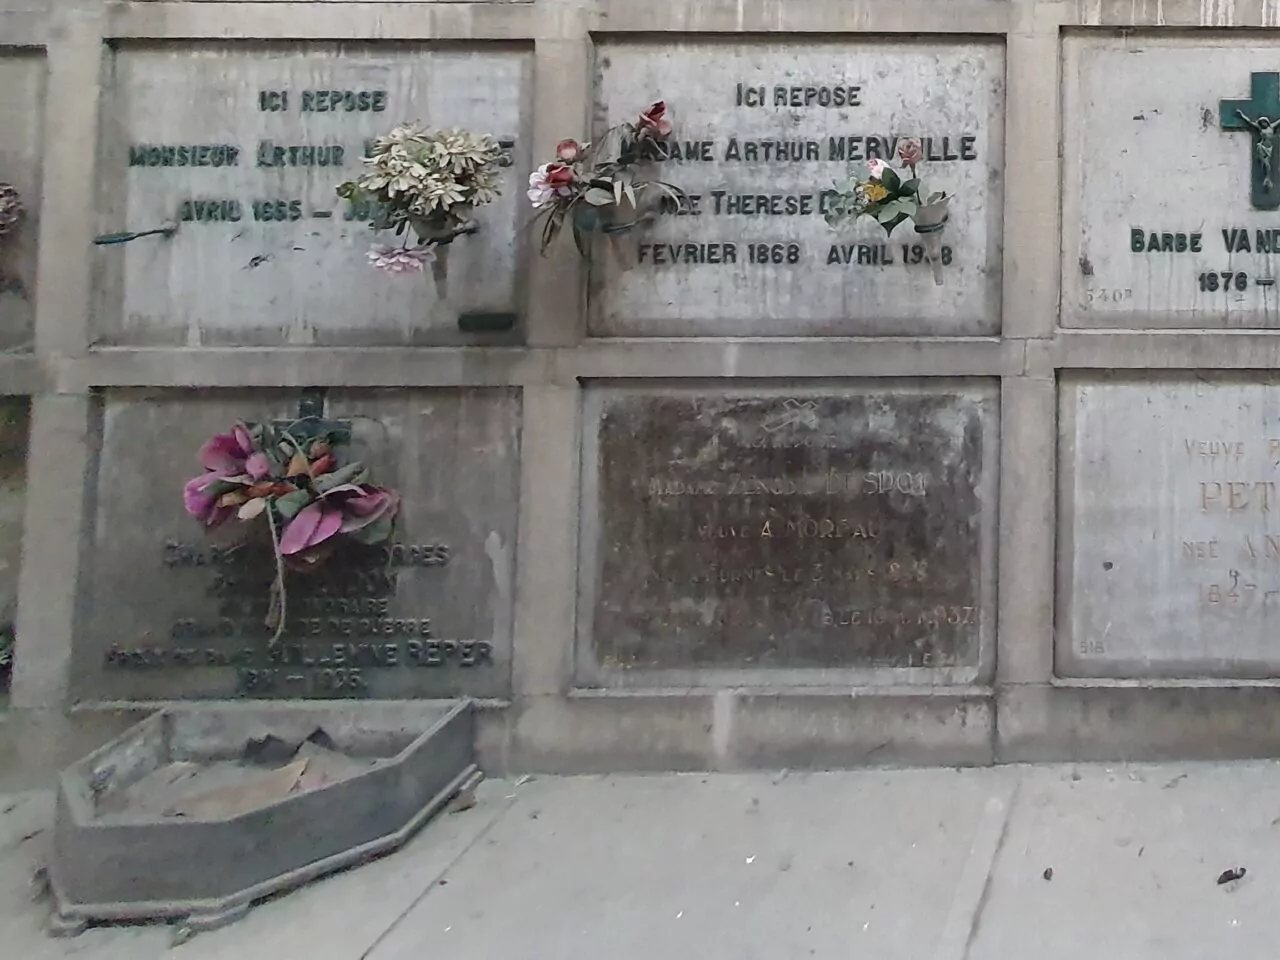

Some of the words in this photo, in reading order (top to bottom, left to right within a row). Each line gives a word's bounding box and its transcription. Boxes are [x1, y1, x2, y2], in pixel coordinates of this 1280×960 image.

[260, 90, 287, 112] ICI
[302, 90, 389, 113] REPOSE
[736, 82, 764, 107] ICI
[774, 85, 862, 107] REPOSE
[129, 144, 240, 168] MONSIEUR
[256, 139, 345, 168] ARTHUR
[725, 138, 820, 162] ARTHUR
[181, 199, 242, 222] AVRIL
[711, 190, 813, 215] THERESE
[1130, 228, 1203, 253] BARBE
[638, 242, 737, 265] FEVRIER
[748, 242, 800, 265] 1868
[826, 243, 893, 265] AVRIL
[902, 243, 953, 266] 198
[1184, 439, 1245, 457] VEUVE
